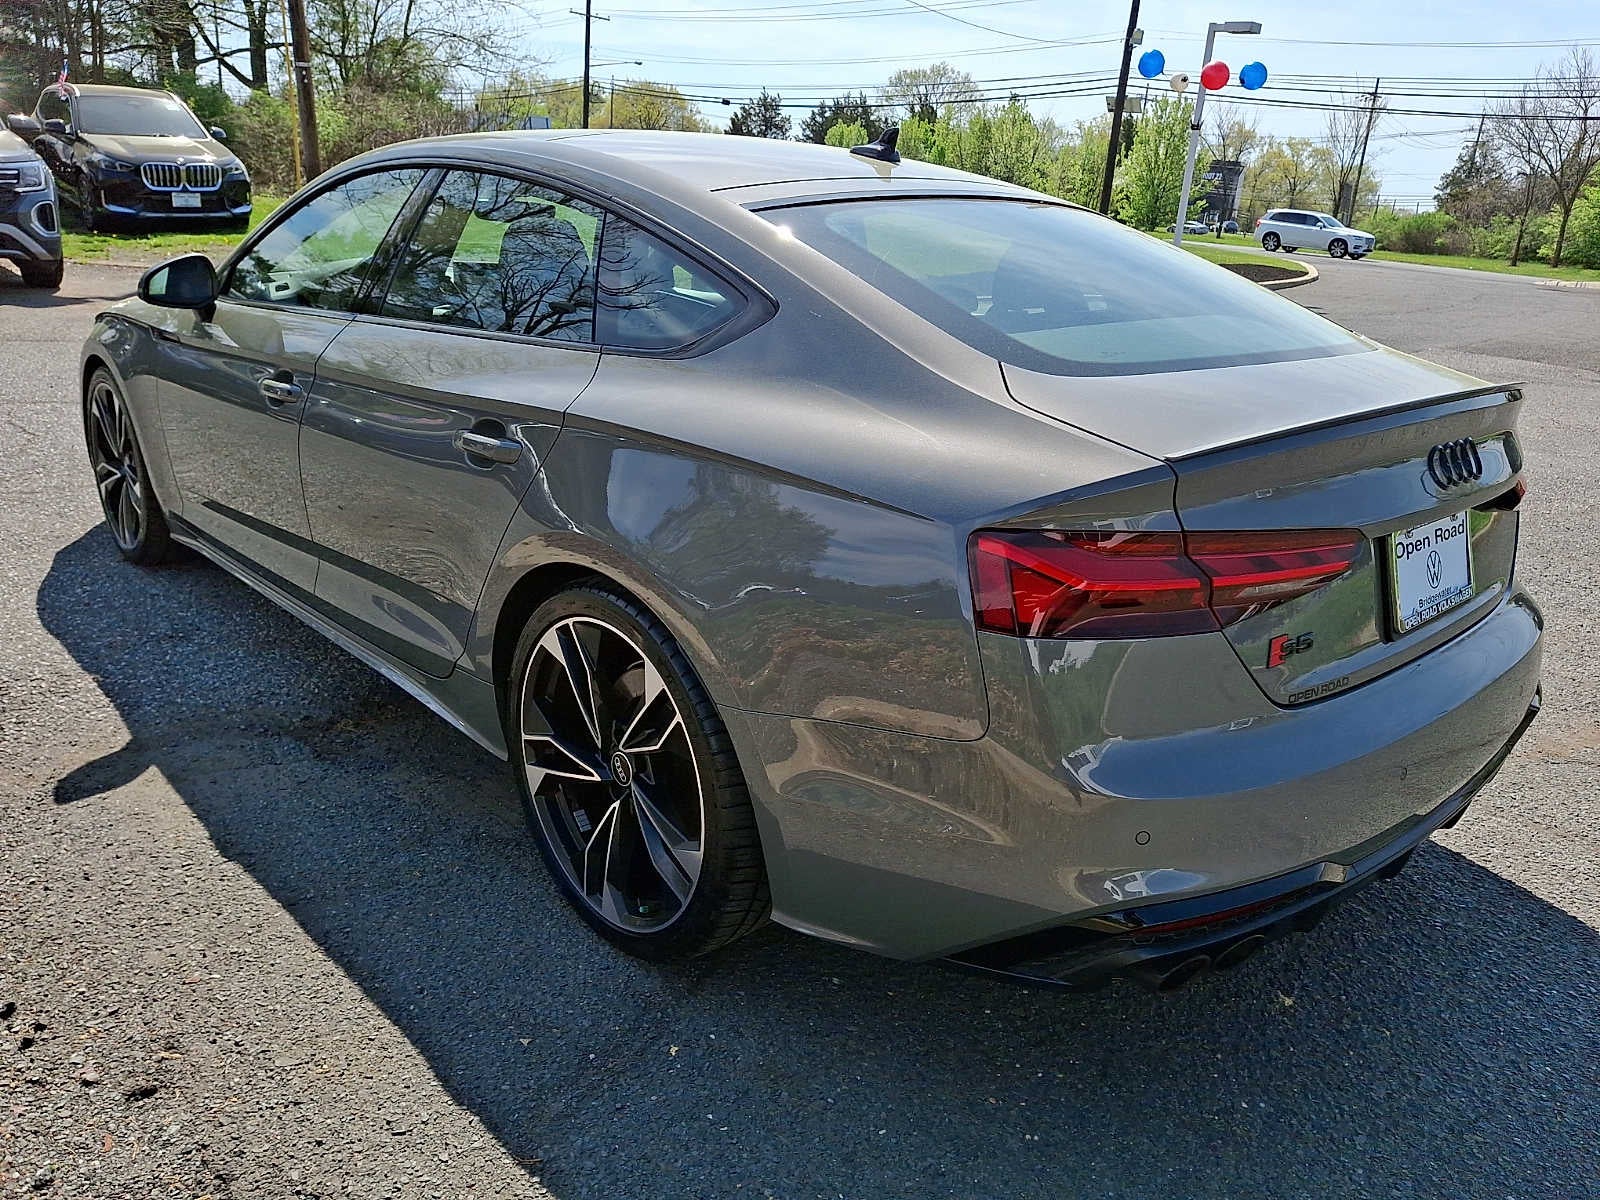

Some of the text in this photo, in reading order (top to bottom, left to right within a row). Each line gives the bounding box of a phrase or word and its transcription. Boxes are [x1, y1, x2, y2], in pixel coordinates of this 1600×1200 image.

[1396, 519, 1465, 560] Open Road
[1405, 611, 1421, 629] OPEN
[1421, 605, 1438, 621] ROAD
[1277, 631, 1314, 659] S5
[1288, 677, 1350, 703] OPEN ROAD
